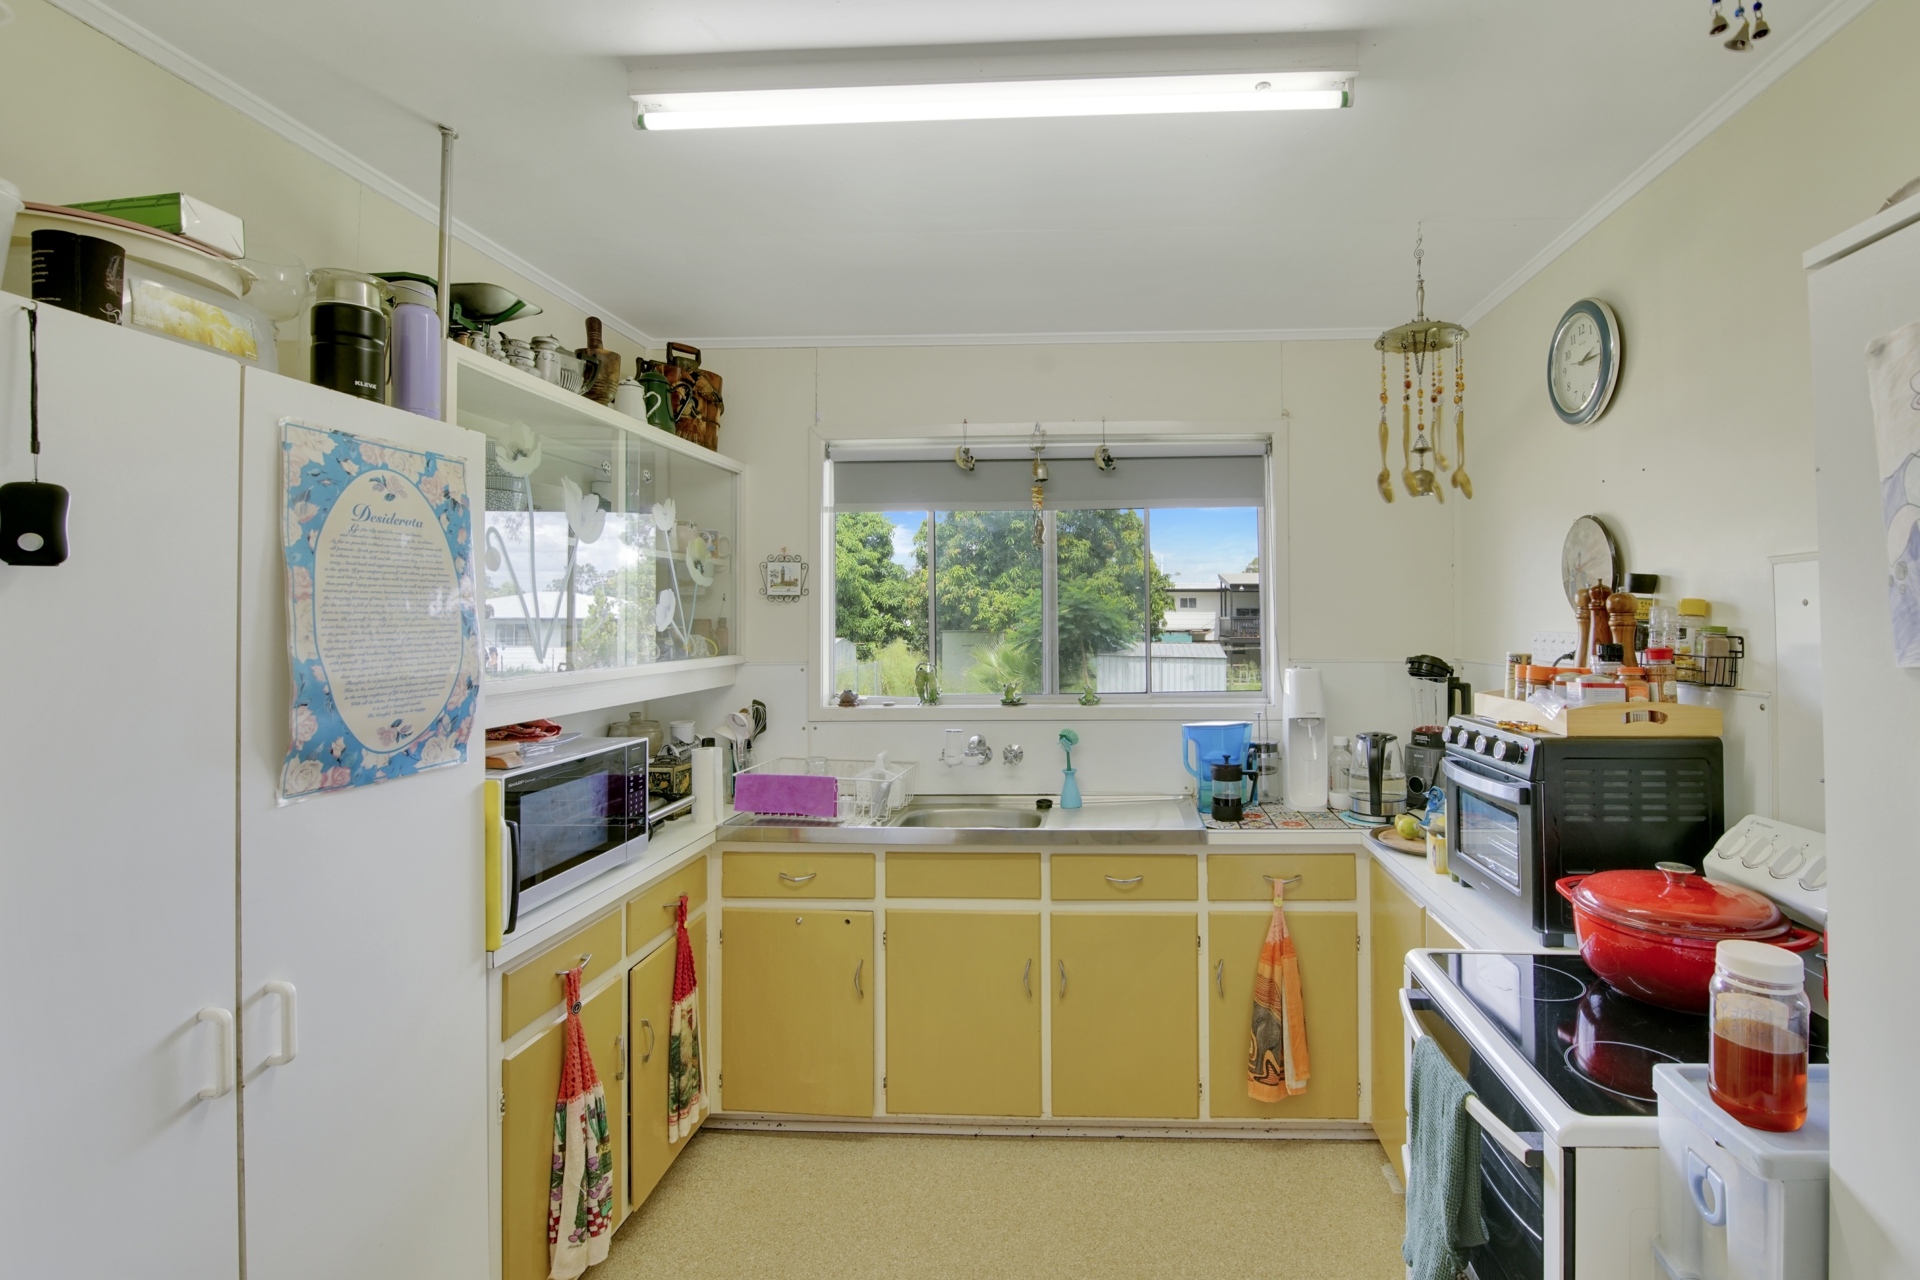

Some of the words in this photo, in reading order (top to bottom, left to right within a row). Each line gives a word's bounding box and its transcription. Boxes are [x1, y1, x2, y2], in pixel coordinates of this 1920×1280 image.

[1578, 323, 1585, 337] 12
[1588, 325, 1593, 335] 1
[1570, 334, 1576, 346] 11
[1565, 350, 1572, 361] 10
[1562, 367, 1567, 378] 9
[1566, 382, 1571, 392] 8
[1573, 390, 1578, 401] 7
[1581, 391, 1587, 403] 6
[351, 503, 424, 528] Desiderata
[508, 779, 524, 788] SHARP
